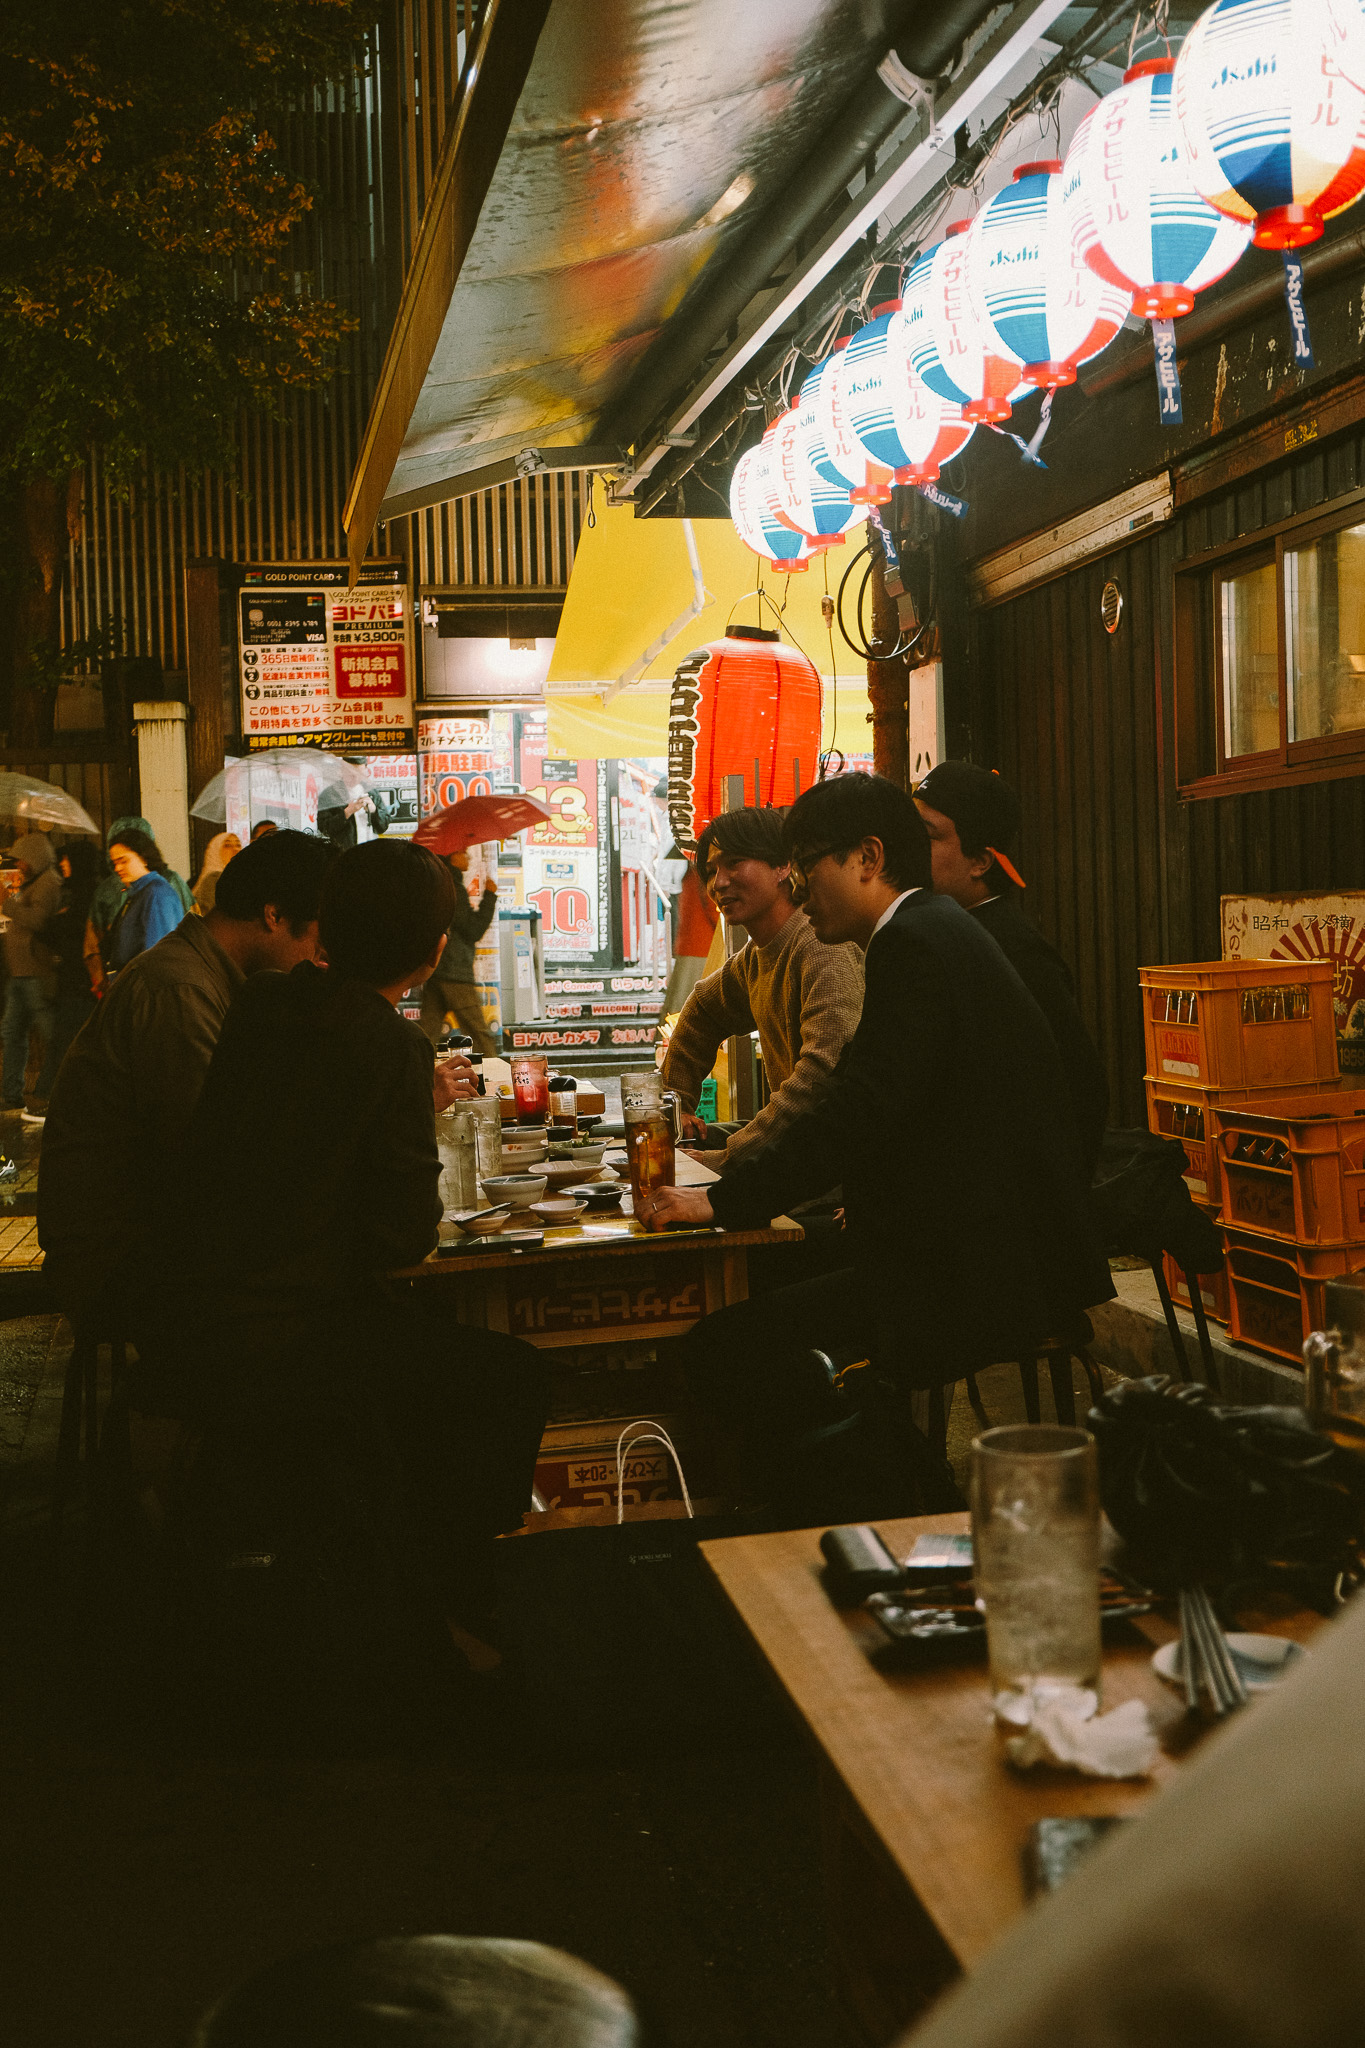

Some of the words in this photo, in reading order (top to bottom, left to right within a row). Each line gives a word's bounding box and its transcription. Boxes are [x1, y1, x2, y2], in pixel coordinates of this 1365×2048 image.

[1211, 54, 1277, 90] Asahi
[1310, 54, 1346, 127] ビール
[1104, 97, 1130, 225] アサヒビール
[1063, 170, 1082, 205] sahi
[989, 245, 1039, 268] Asahi
[942, 250, 968, 357] アサヒビール
[1287, 264, 1311, 358] アサヒビール
[902, 303, 924, 334] sahi
[1156, 332, 1179, 414] アサヒビール
[848, 376, 882, 397] Asahi
[781, 424, 802, 508] アサヒビール
[738, 457, 754, 535] アサヒビール
[265, 573, 287, 581] GOLD
[288, 573, 312, 581] POINT
[313, 573, 335, 581] CARD
[332, 604, 404, 621] ヨドバシ
[344, 622, 393, 630] PREMIUM
[306, 633, 326, 643] VISA
[261, 653, 315, 665] 365日間補償
[341, 655, 400, 672] 新規会員
[348, 671, 392, 688] 募集中
[249, 701, 384, 716] この他にもプレミアム会員様
[250, 713, 405, 730] 専用特典を数多くご用意しました
[249, 730, 406, 748] 通常会員様のアップグレードも受付中
[526, 785, 596, 833] 13%
[532, 831, 588, 845] ポイント還元
[529, 848, 592, 857] ゴールドポイントカード
[526, 887, 596, 936] 10%
[1253, 914, 1289, 931] 昭和
[1302, 913, 1351, 931] アメ横
[563, 979, 604, 992] Camera
[593, 1004, 637, 1015] WELCOME!
[513, 1030, 601, 1047] ヨドバシカメラ
[514, 1282, 701, 1328] アサヒビール
